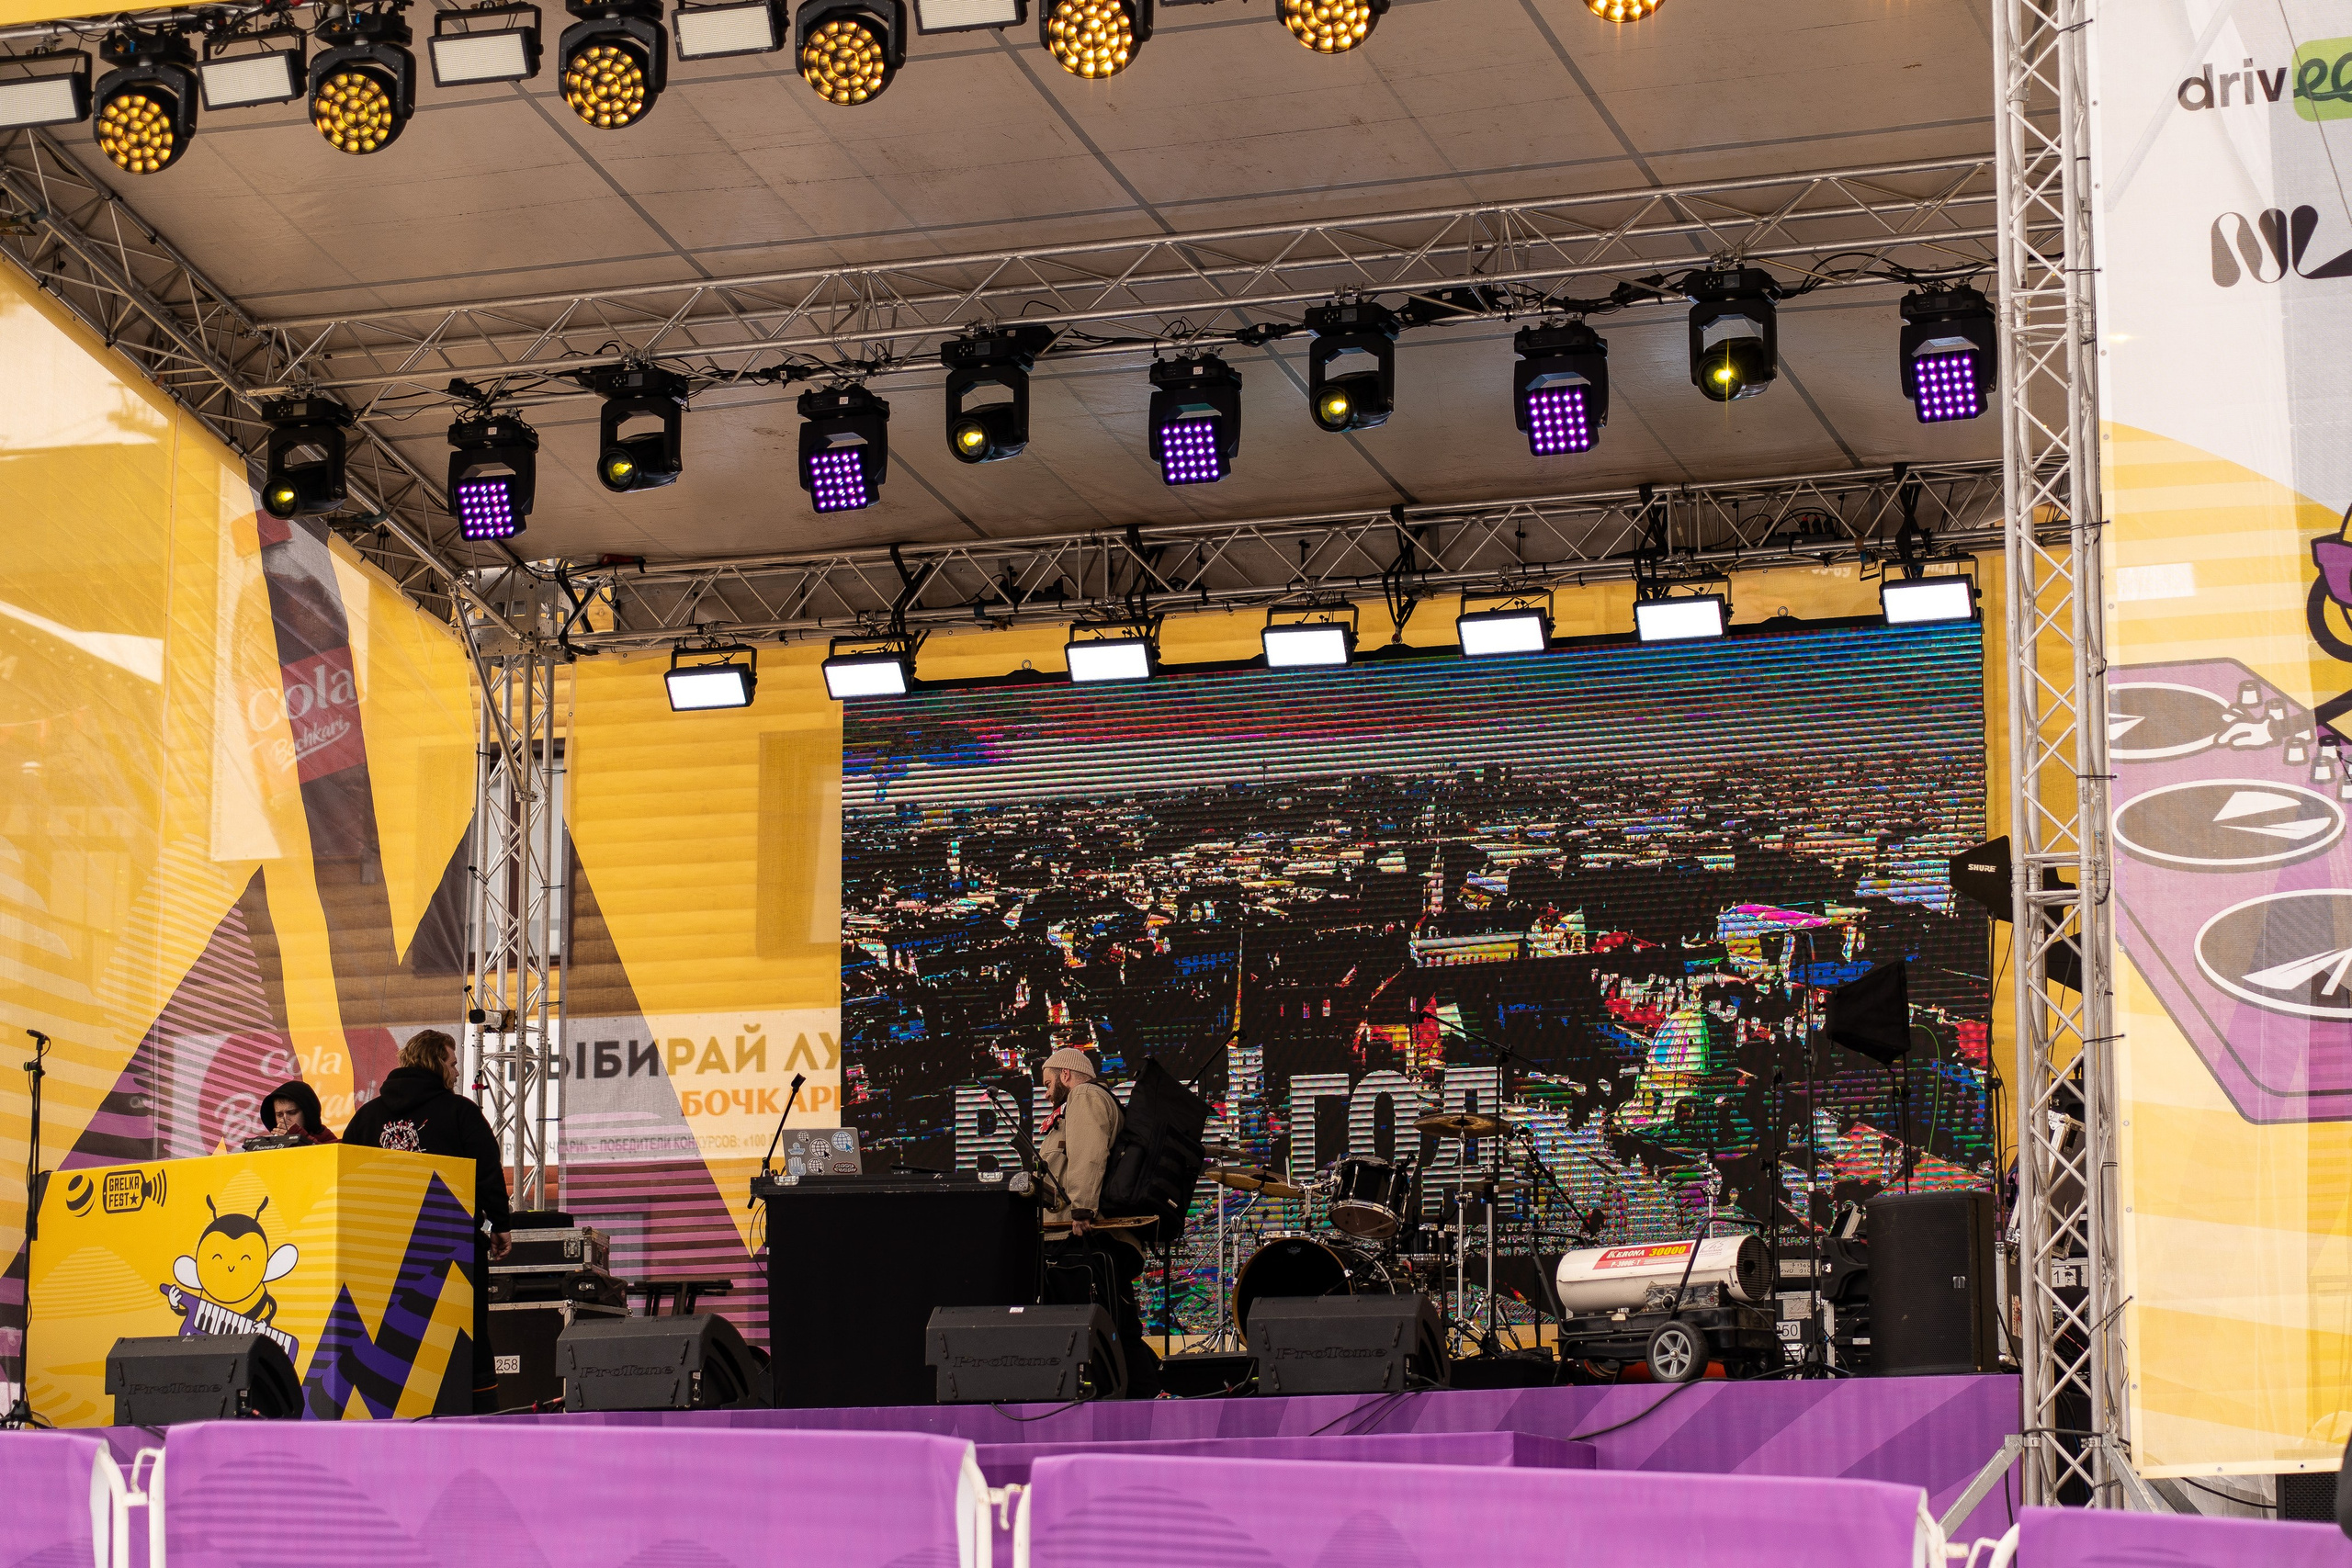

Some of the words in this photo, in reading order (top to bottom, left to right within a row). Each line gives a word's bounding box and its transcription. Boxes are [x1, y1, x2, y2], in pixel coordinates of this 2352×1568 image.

[248, 663, 357, 732] Cola
[271, 714, 348, 765] Bochkari
[1968, 863, 1996, 872] SHURE
[260, 1046, 342, 1077] Cola
[109, 1176, 140, 1192] GRELKA
[109, 1192, 130, 1208] FEST
[1606, 1249, 1645, 1258] KERONA
[1649, 1245, 1687, 1257] 30000
[1275, 1347, 1388, 1359] ProTone
[496, 1359, 518, 1371] 258
[953, 1355, 1062, 1368] ProTone
[580, 1365, 675, 1378] ProTone
[128, 1382, 222, 1395] ProTone
